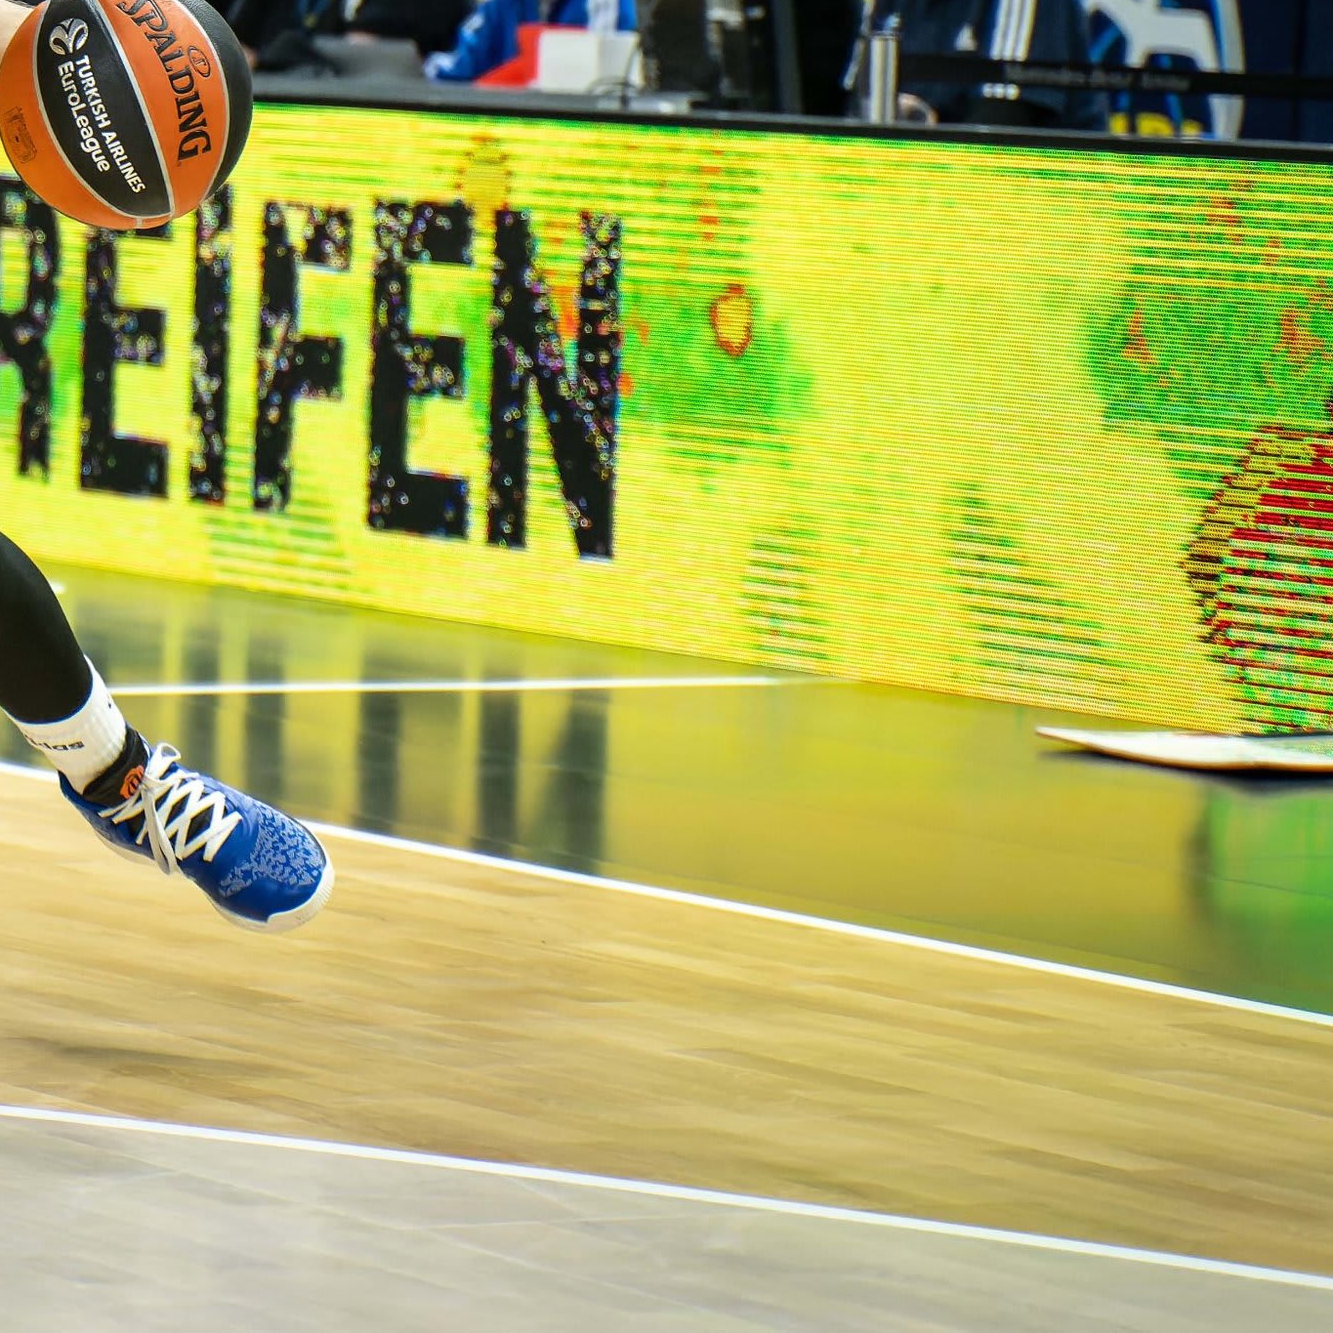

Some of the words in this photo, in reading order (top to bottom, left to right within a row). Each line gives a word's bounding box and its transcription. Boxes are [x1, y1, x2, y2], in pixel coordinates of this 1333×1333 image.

[57, 60, 111, 173] EuroLeague
[74, 55, 109, 130] TURKISH
[100, 128, 146, 195] AIRLINES
